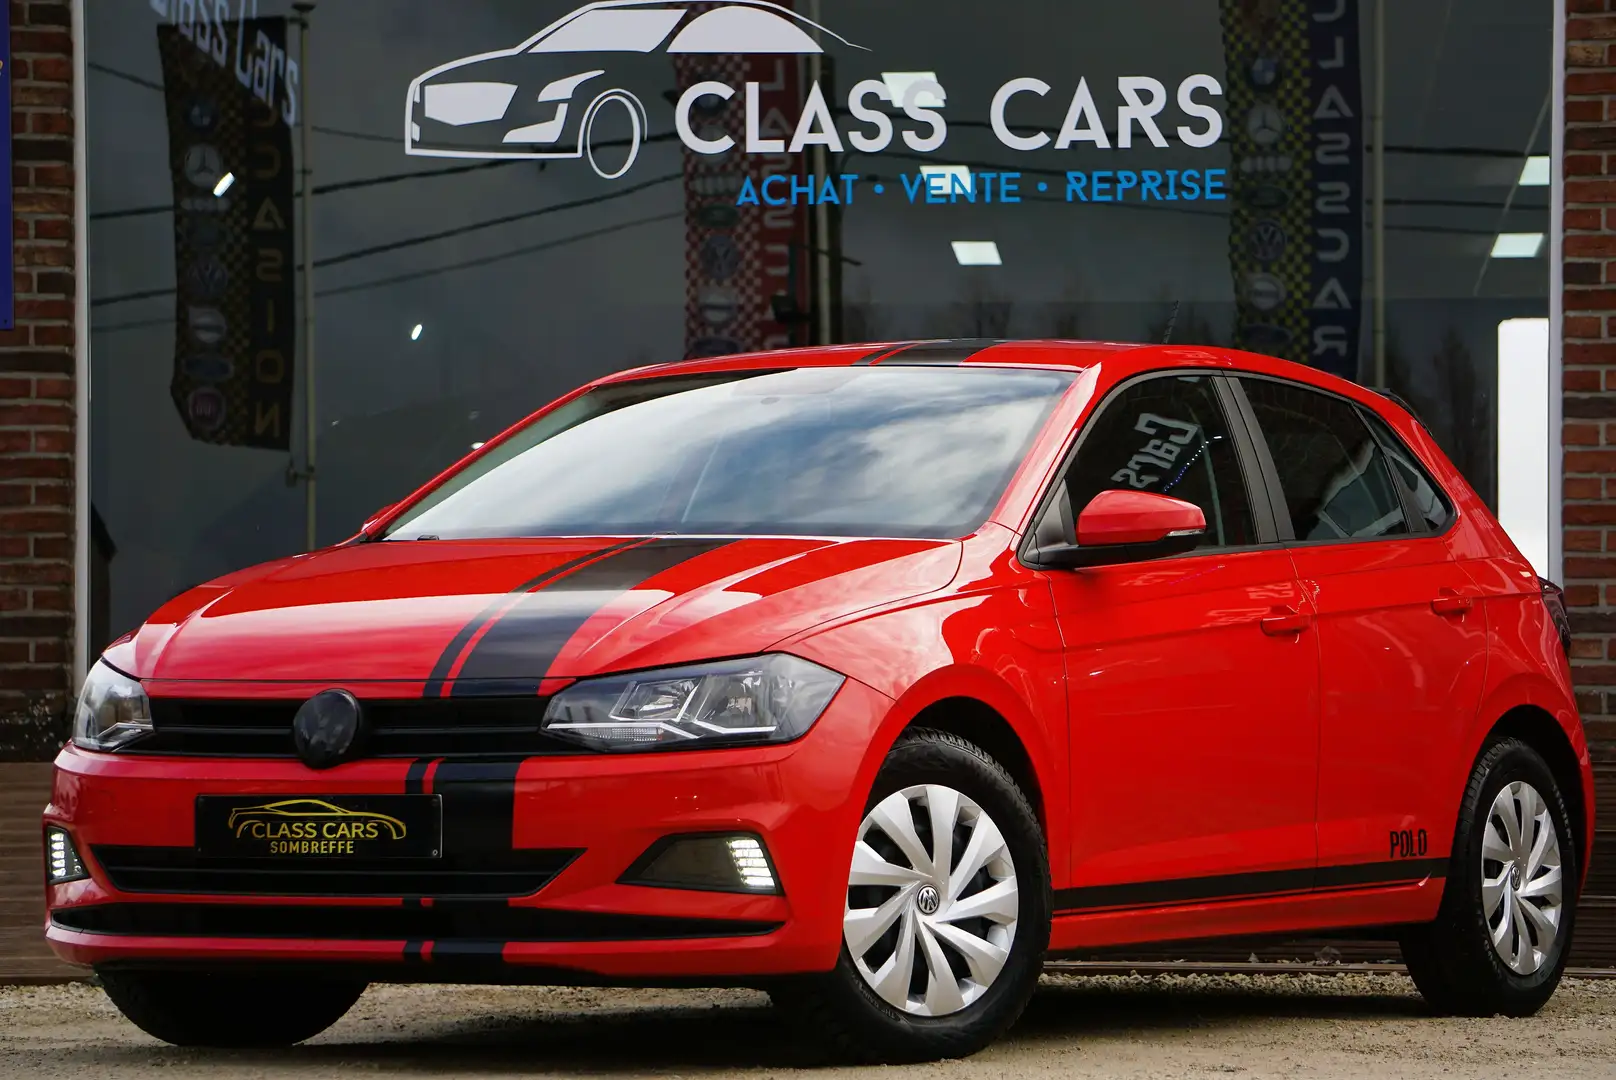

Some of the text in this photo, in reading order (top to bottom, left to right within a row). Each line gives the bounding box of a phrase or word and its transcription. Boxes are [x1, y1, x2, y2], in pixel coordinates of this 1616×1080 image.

[675, 74, 1223, 154] CLASS CARS
[736, 168, 1227, 206] ACHAT VENTE REPRISE
[251, 822, 379, 839] CLASS CARS
[1389, 829, 1428, 858] POLO
[270, 840, 354, 854] SOMBREFFE
